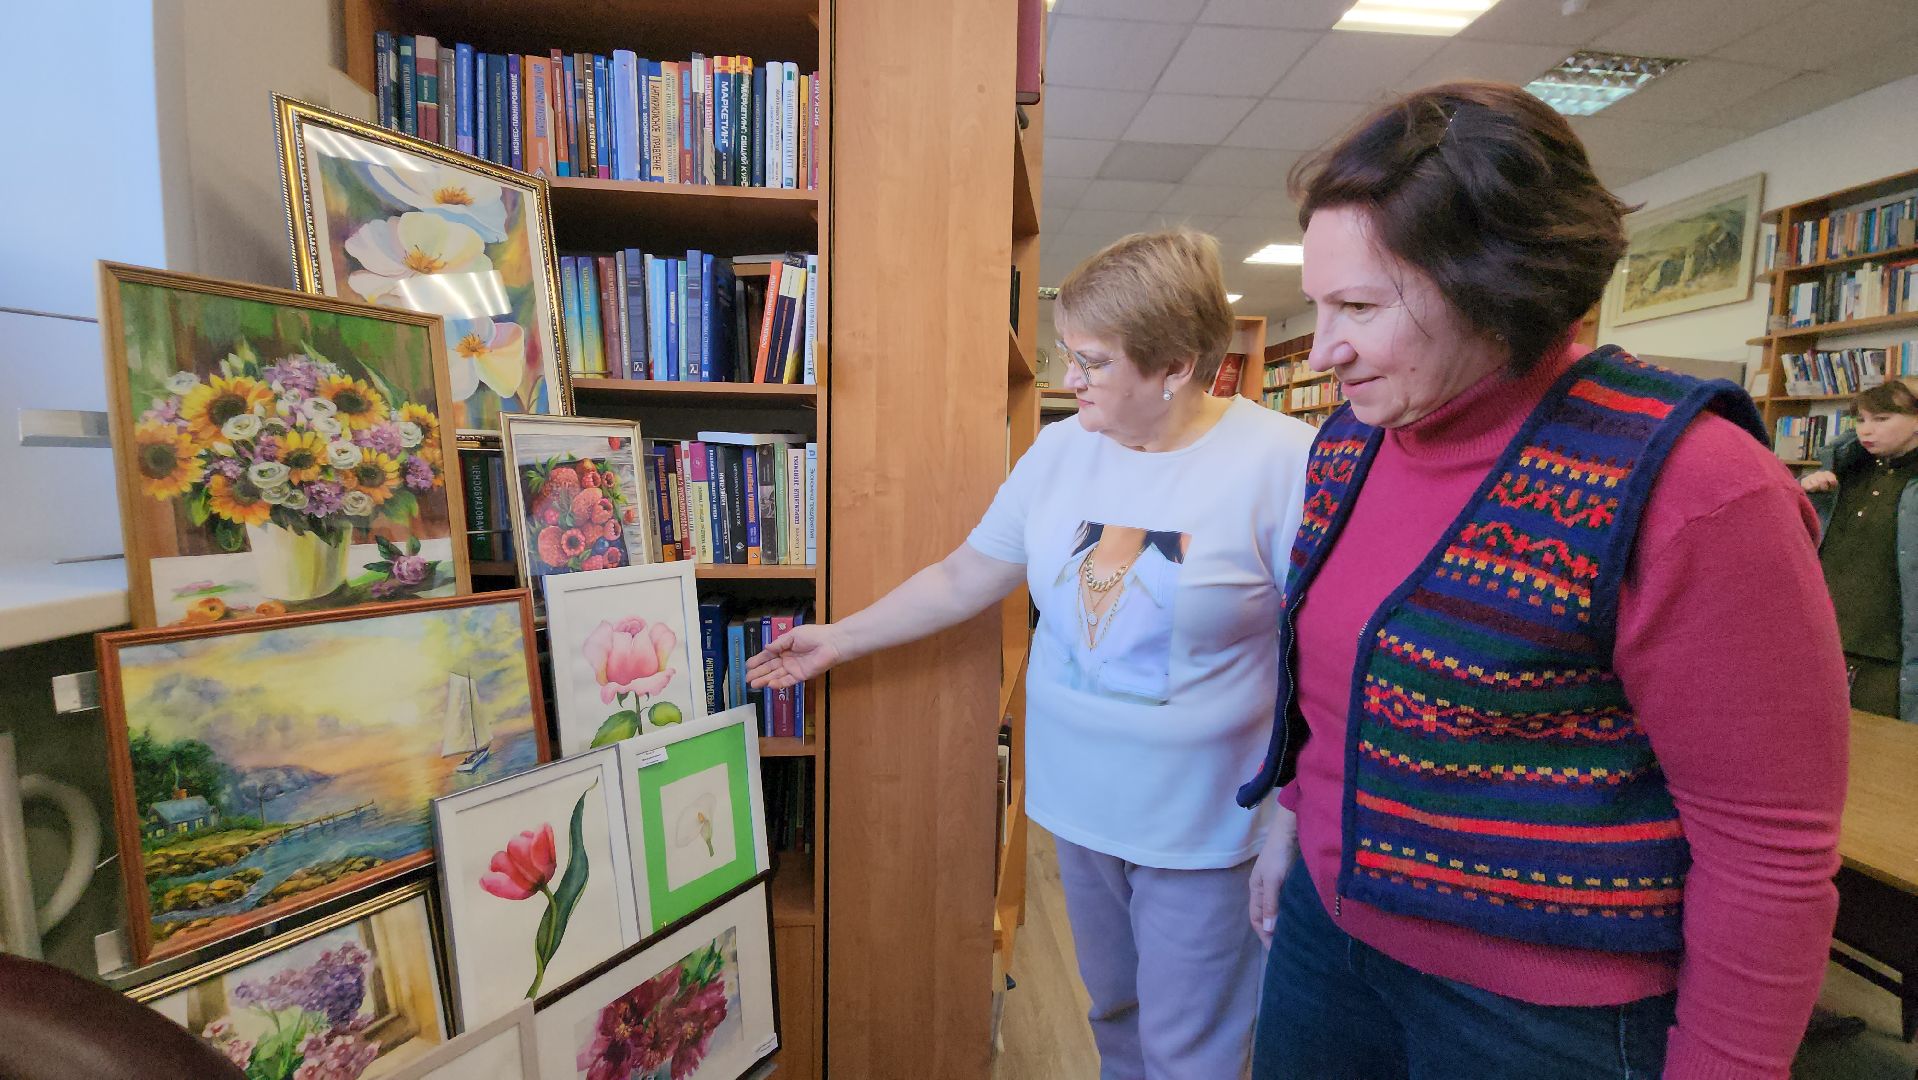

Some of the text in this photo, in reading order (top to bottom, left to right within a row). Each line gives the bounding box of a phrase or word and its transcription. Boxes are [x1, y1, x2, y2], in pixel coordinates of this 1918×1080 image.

[511, 72, 520, 156] БИЗНЕС-ПЛАНИРОВАНИЕ
[651, 84, 661, 171] АНТИКРИЗИСНОЕ УПРАВЛЕНИЕ
[721, 81, 729, 148] МАРКЕТИНГ
[739, 135, 748, 165] ОБЩИЙ
[740, 165, 749, 188] КУРС
[471, 465, 486, 541] ЦЕНООБРАЗОВАНИЕ
